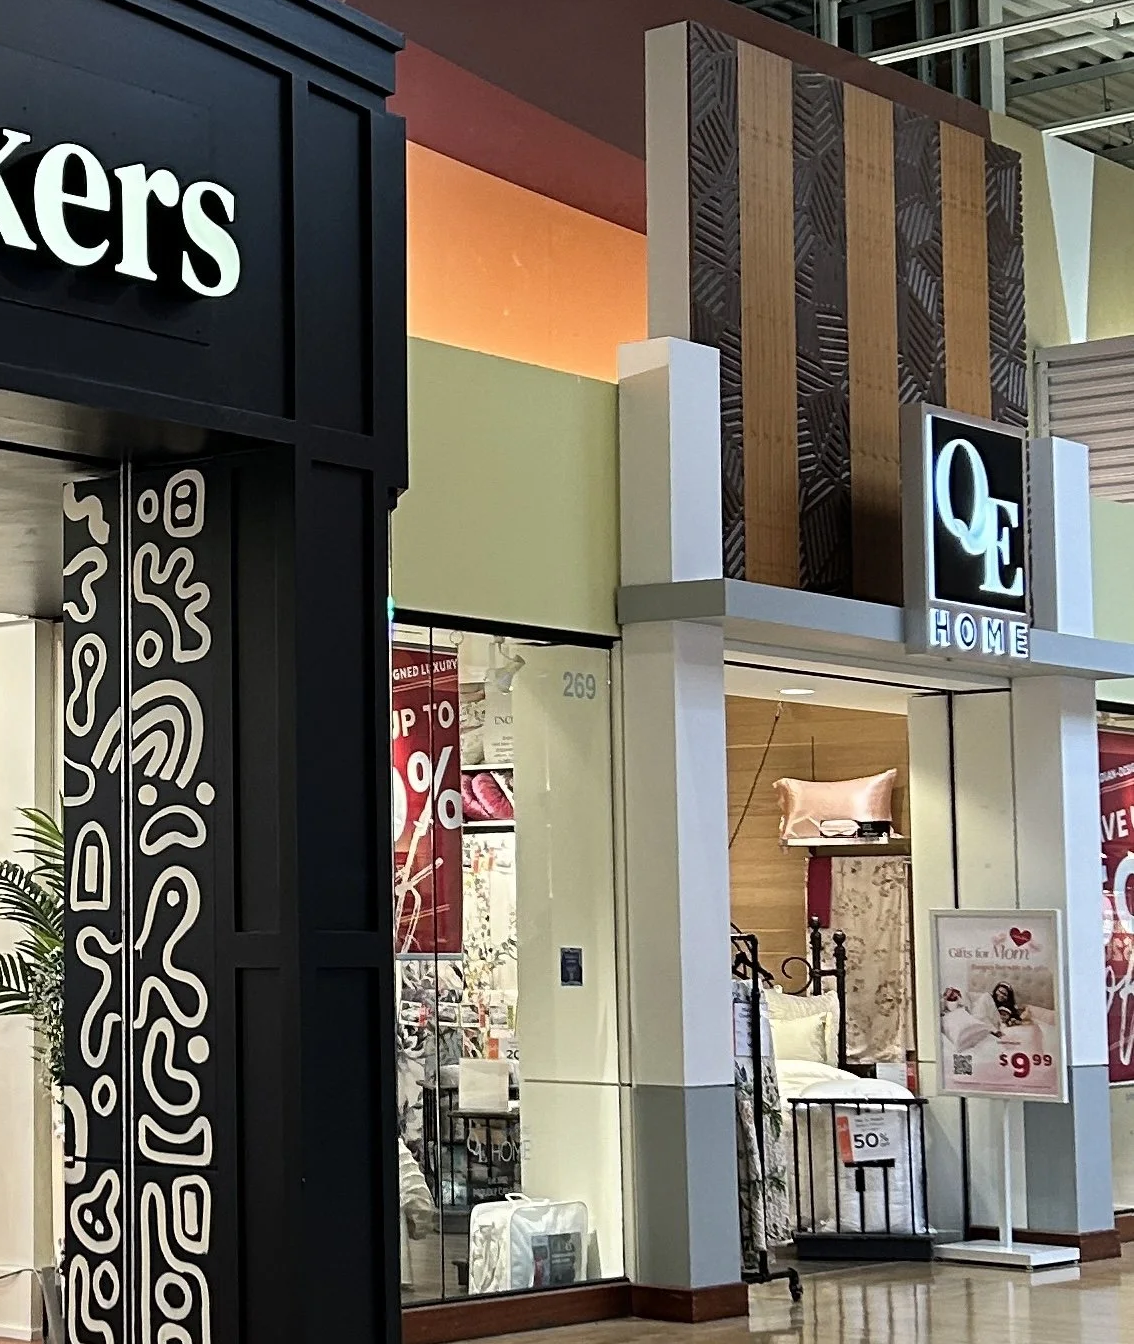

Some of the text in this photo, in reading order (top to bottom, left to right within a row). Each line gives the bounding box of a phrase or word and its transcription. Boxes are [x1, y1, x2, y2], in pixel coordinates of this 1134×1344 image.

[935, 438, 1024, 597] QE
[929, 607, 1029, 658] HOME
[563, 671, 596, 700] 269
[423, 700, 454, 729] TO
[948, 944, 1030, 960] Gifts for Mom
